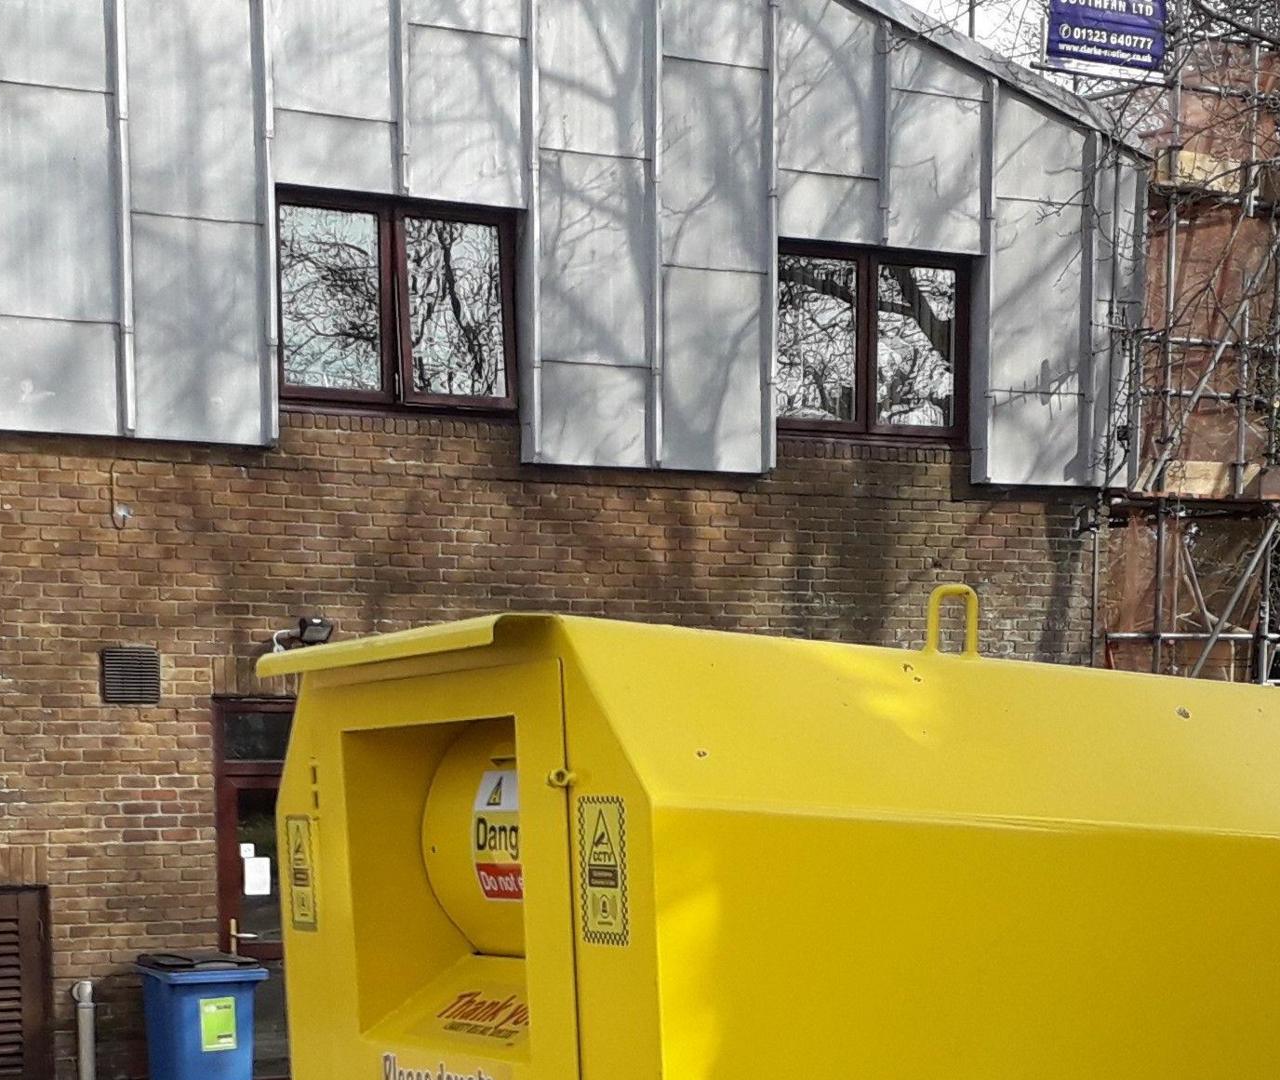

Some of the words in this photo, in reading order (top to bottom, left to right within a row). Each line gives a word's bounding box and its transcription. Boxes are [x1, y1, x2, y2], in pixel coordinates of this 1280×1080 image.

[1132, 2, 1154, 17] LTD
[1073, 27, 1107, 43] 01323
[1110, 33, 1153, 50] 640777
[593, 851, 612, 862] CCTV
[480, 871, 498, 890] Do
[500, 872, 517, 892] not
[437, 990, 517, 1022] Thank
